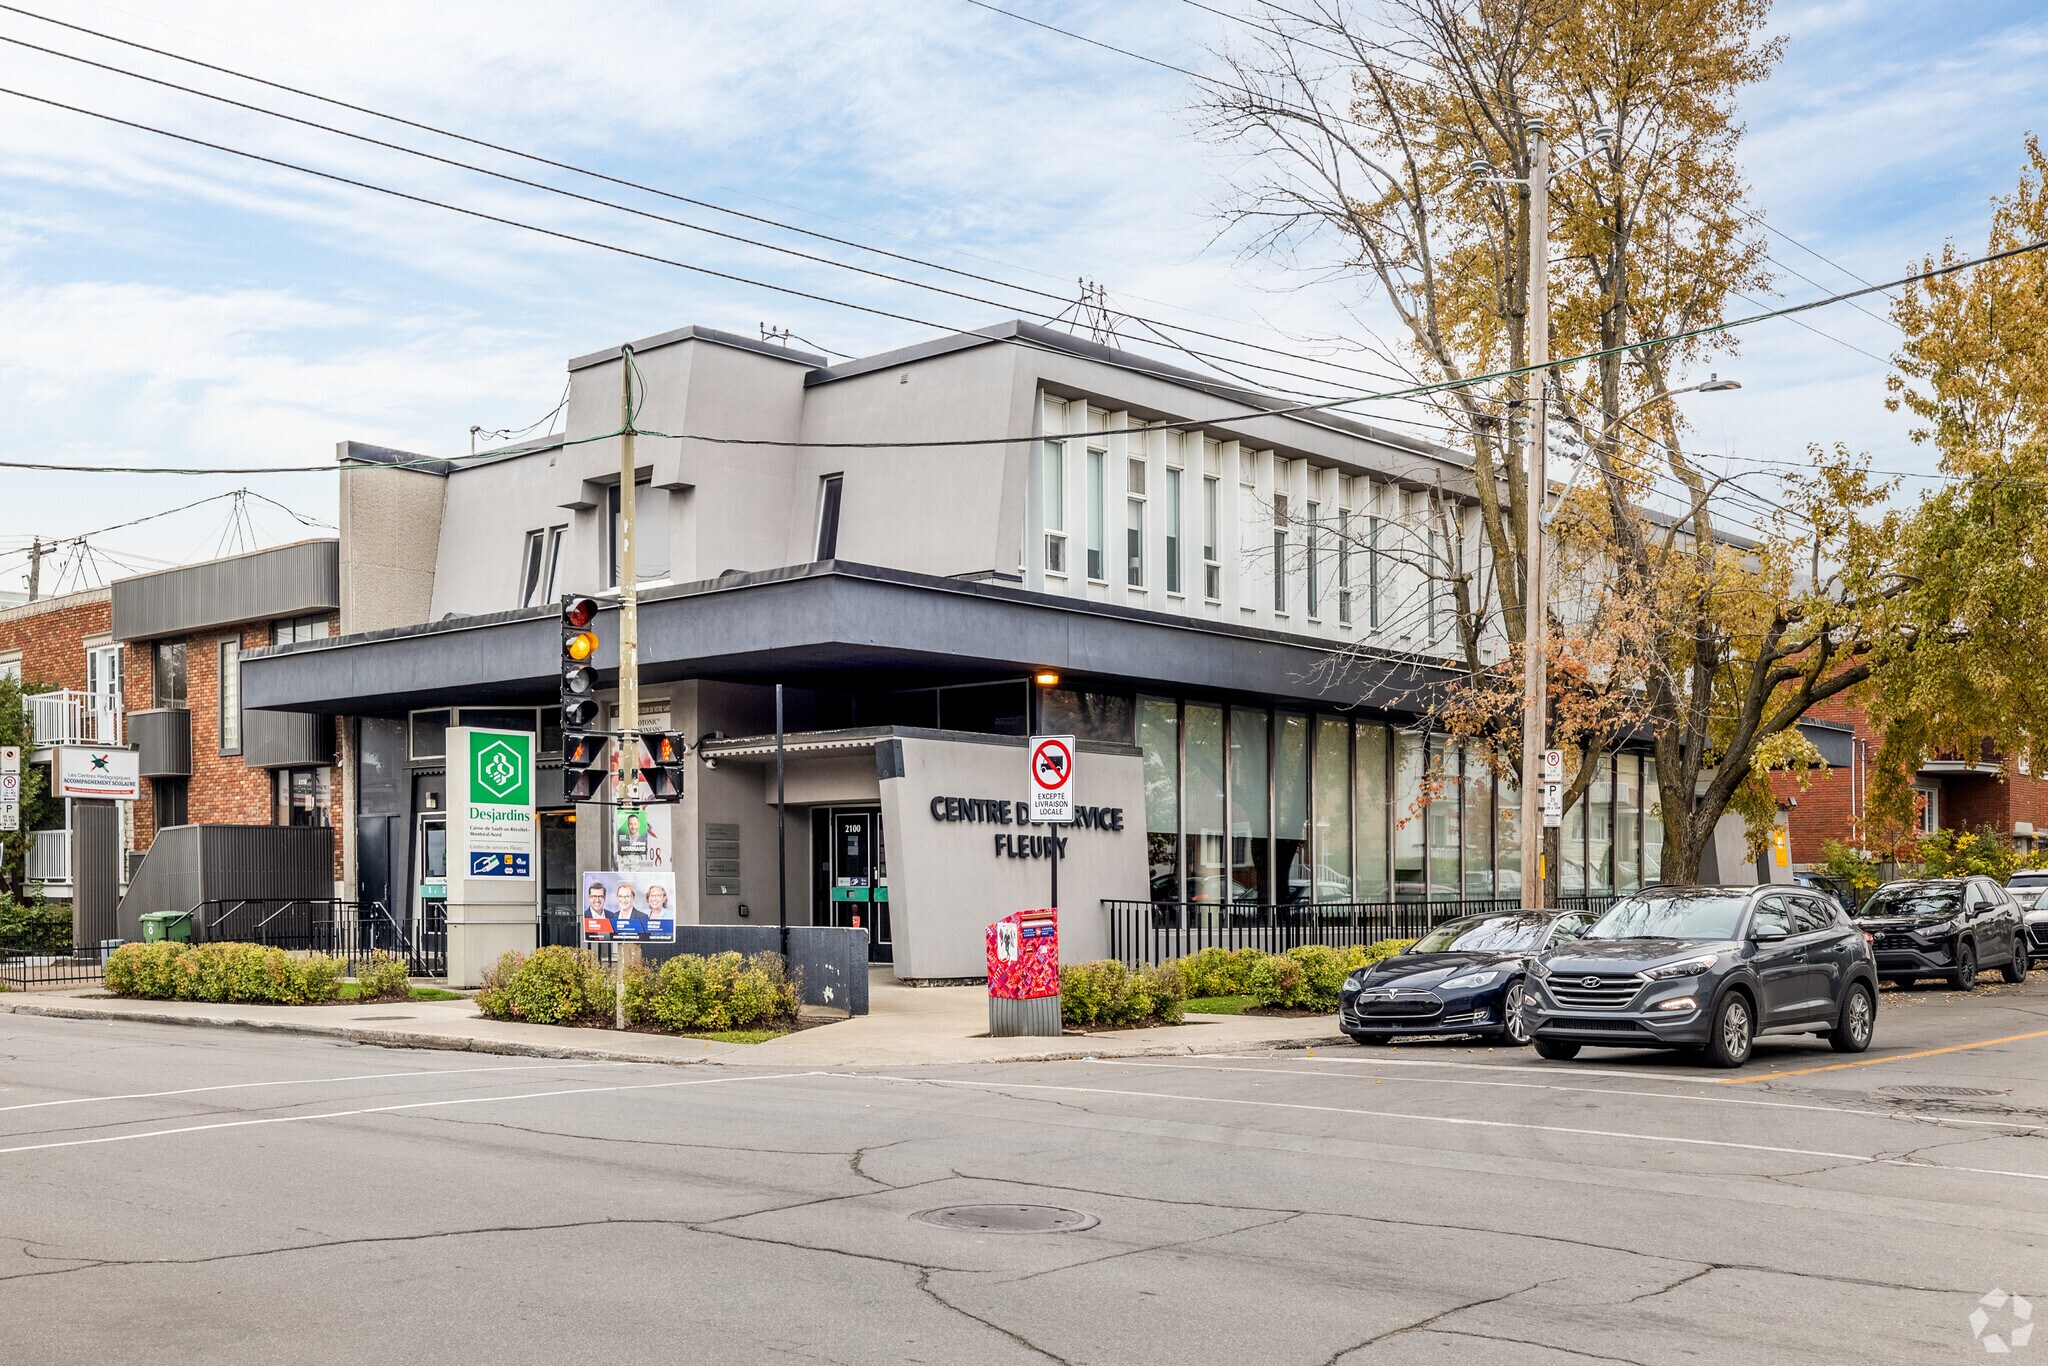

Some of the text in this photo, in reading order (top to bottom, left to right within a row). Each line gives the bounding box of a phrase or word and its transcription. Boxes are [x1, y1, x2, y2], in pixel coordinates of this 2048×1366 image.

[63, 778, 112, 786] ACCOMPAGNEMENT
[1549, 785, 1557, 796] P
[6, 805, 12, 813] P
[930, 796, 1012, 825] CENTRE
[1048, 805, 1124, 831] RVICE
[469, 807, 530, 823] Desjardins
[845, 824, 861, 833] 2100
[995, 833, 1069, 859] FLEURY
